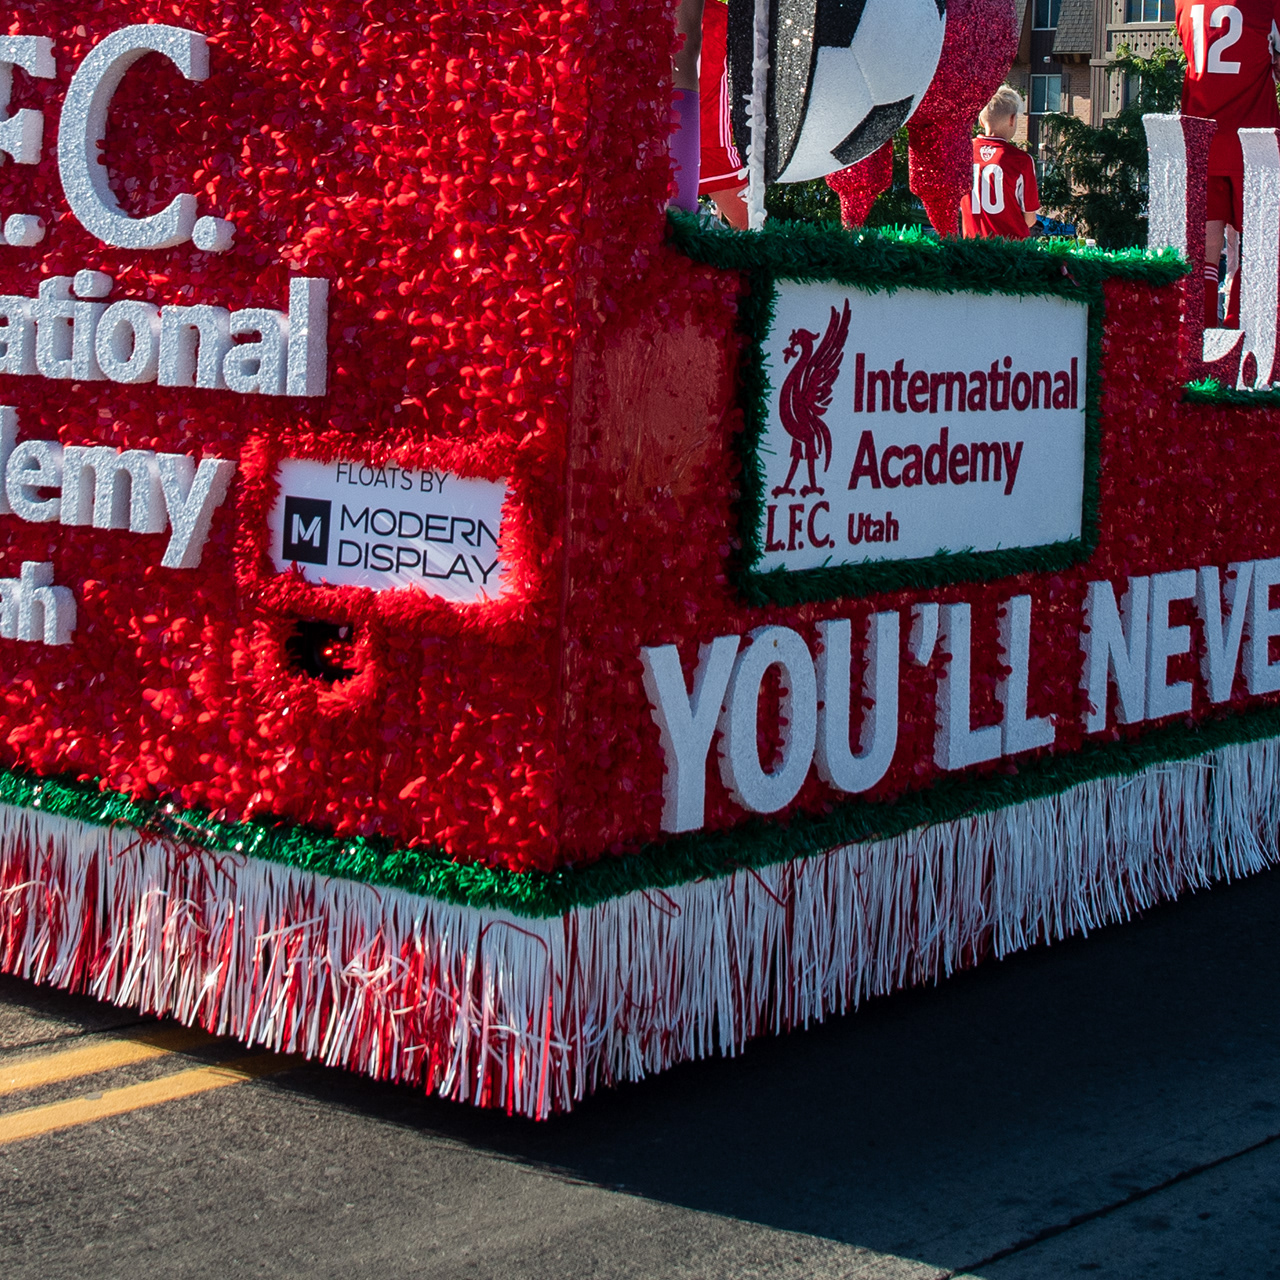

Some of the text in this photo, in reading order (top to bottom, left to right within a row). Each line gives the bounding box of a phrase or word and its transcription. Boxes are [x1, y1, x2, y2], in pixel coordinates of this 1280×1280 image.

[1190, 4, 1243, 74] 12
[971, 163, 1005, 215] 10
[854, 353, 1078, 414] International
[336, 462, 449, 494] FLOATS BY
[848, 426, 1024, 496] Academy
[340, 504, 503, 550] MODERN
[765, 501, 835, 552] L.F.C.
[848, 511, 899, 545] Utah
[338, 539, 501, 584] DISPLAY
[640, 595, 1055, 835] YOU'LL
